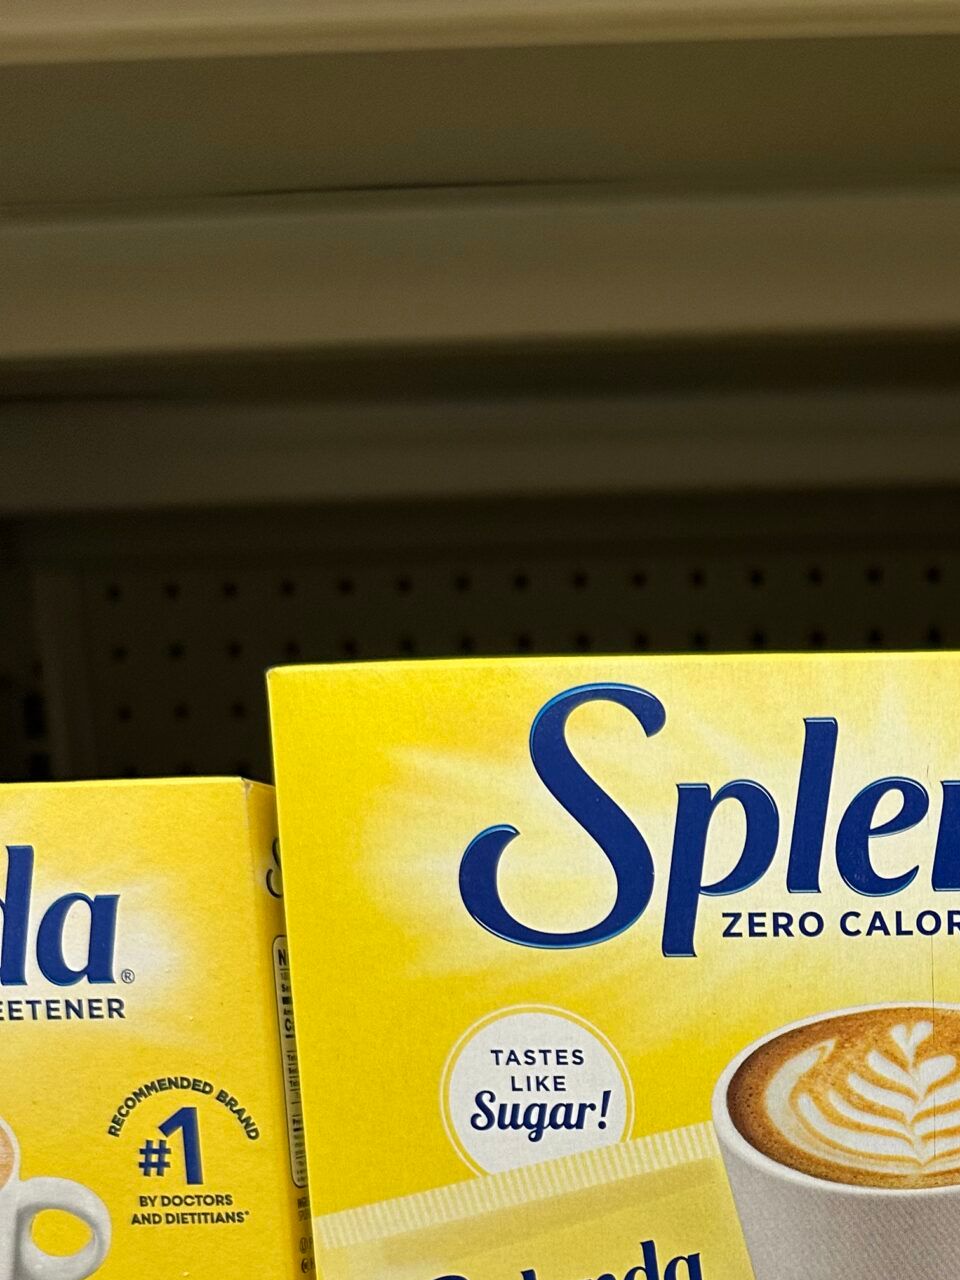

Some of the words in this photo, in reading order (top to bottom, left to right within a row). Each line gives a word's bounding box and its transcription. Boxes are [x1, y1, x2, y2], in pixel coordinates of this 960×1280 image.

[722, 911, 824, 938] ZERO
[0, 998, 126, 1021] ETENER
[490, 1049, 585, 1066] TASTES
[510, 1075, 567, 1092] LIKE
[108, 1076, 214, 1138] RECOMMENDED
[215, 1089, 260, 1141] BRAND
[470, 1089, 612, 1142] Sugar!
[138, 1106, 204, 1185] #1
[139, 1195, 158, 1208] BY
[161, 1194, 233, 1207] DOCTORS
[131, 1213, 163, 1225] AND
